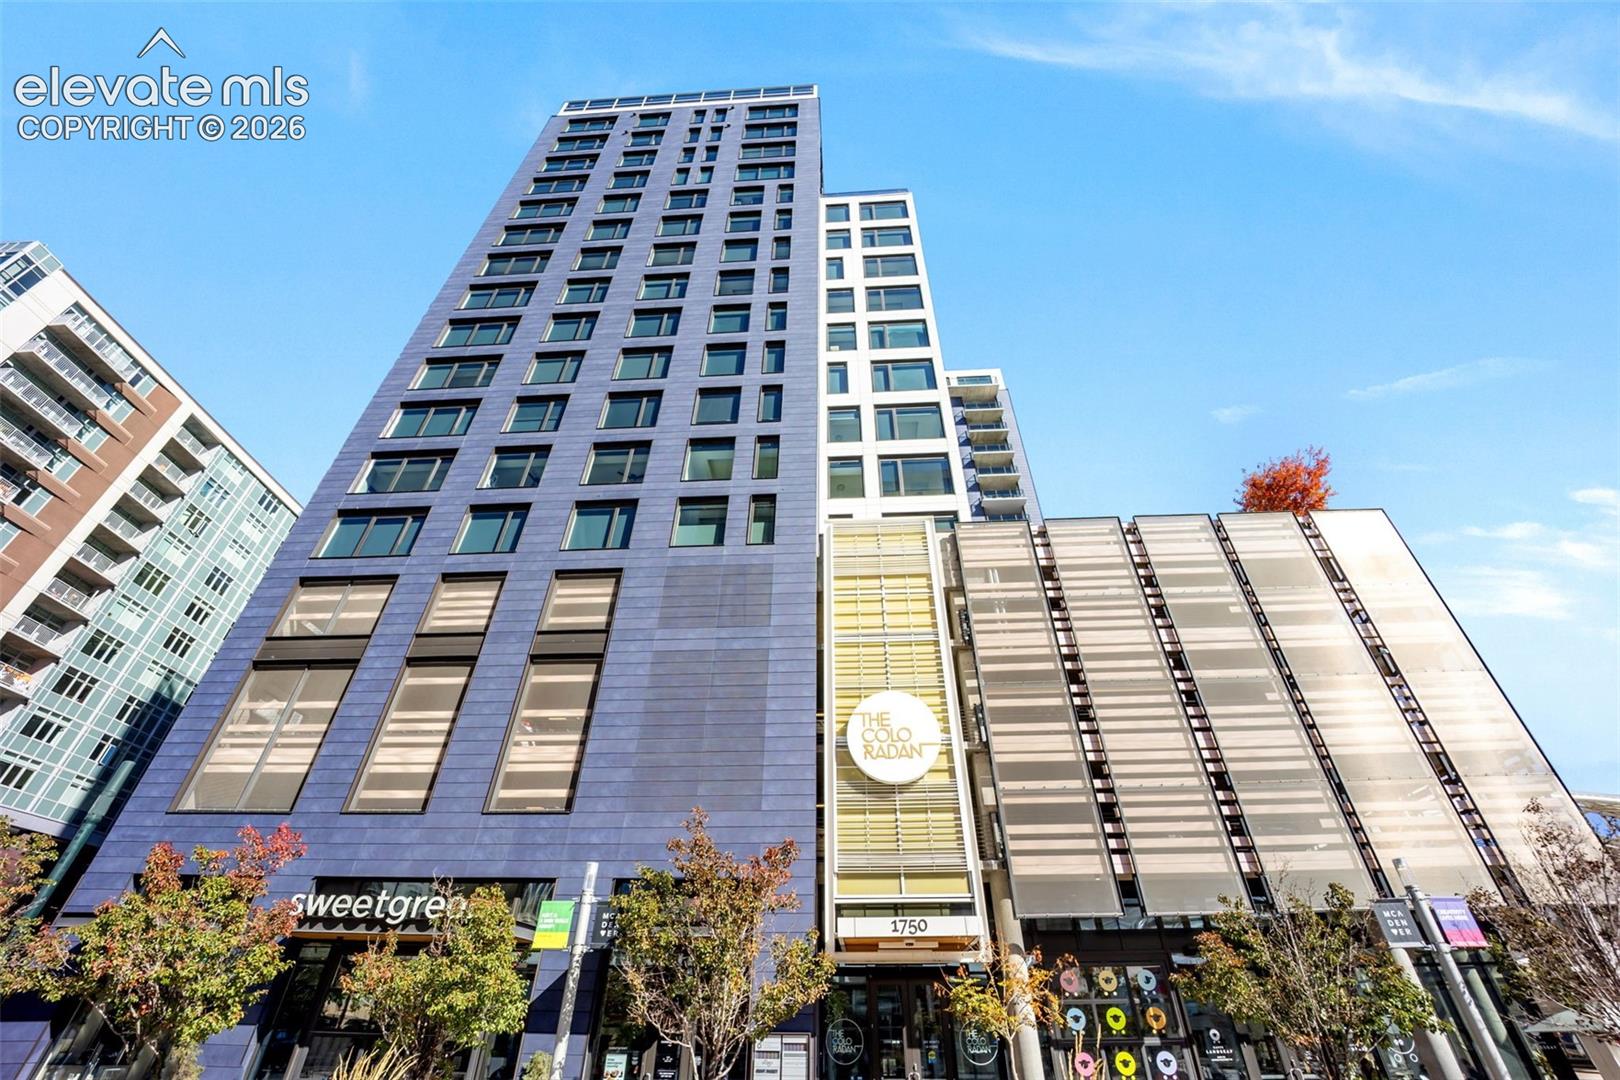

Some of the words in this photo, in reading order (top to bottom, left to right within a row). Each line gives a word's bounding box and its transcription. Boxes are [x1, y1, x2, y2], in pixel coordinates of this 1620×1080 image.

[859, 711, 891, 728] THE
[861, 727, 913, 743] COLO
[863, 743, 924, 760] RADAN
[890, 919, 928, 935] 1750
[1386, 919, 1409, 927] DEN
